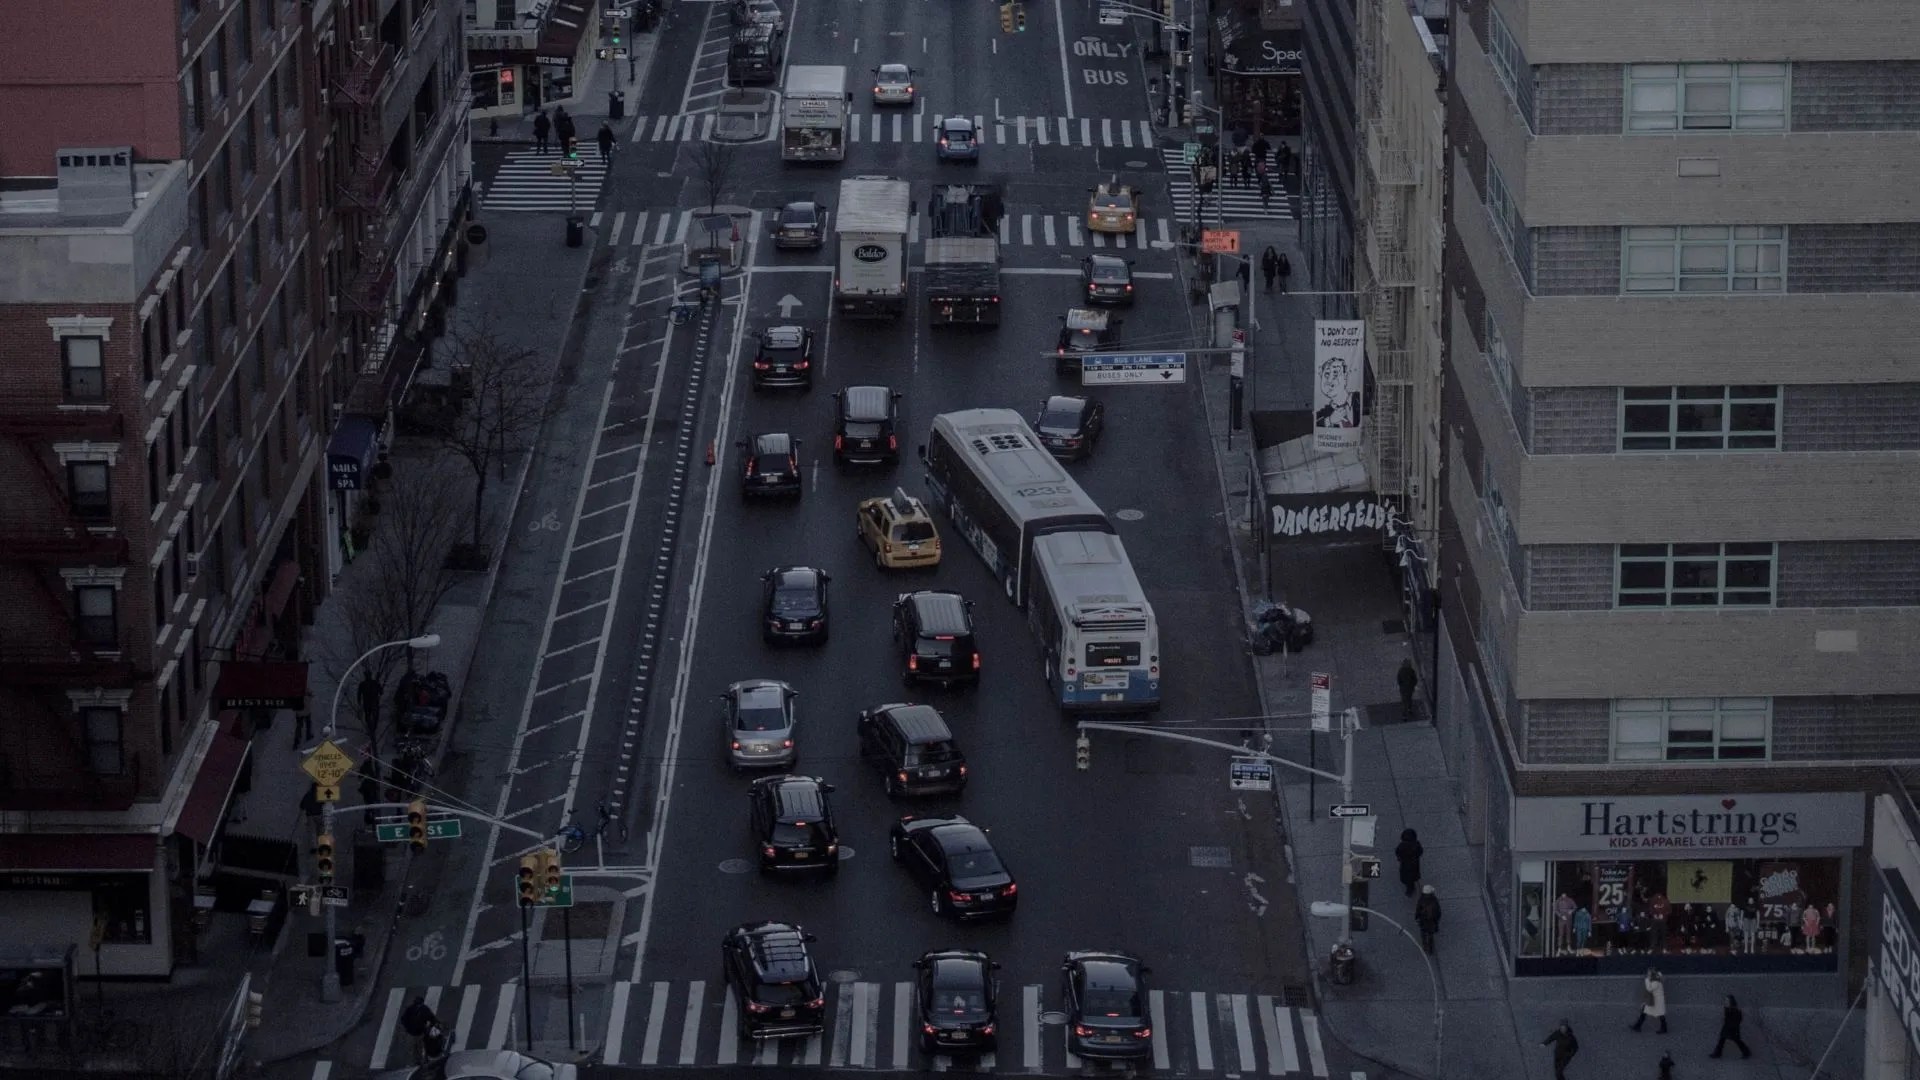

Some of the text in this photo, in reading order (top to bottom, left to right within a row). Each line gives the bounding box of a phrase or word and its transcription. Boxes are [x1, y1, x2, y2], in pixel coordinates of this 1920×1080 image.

[1073, 40, 1132, 58] ONLY
[1083, 68, 1129, 85] BUS
[858, 248, 886, 259] Baldor
[332, 463, 358, 472] NAILS
[337, 479, 355, 489] SPA
[1580, 802, 1798, 845] Hartstrings
[394, 824, 444, 837] E St
[1609, 836, 1747, 848] KIDS APPAREL CENTER
[1882, 892, 1911, 978] BED
